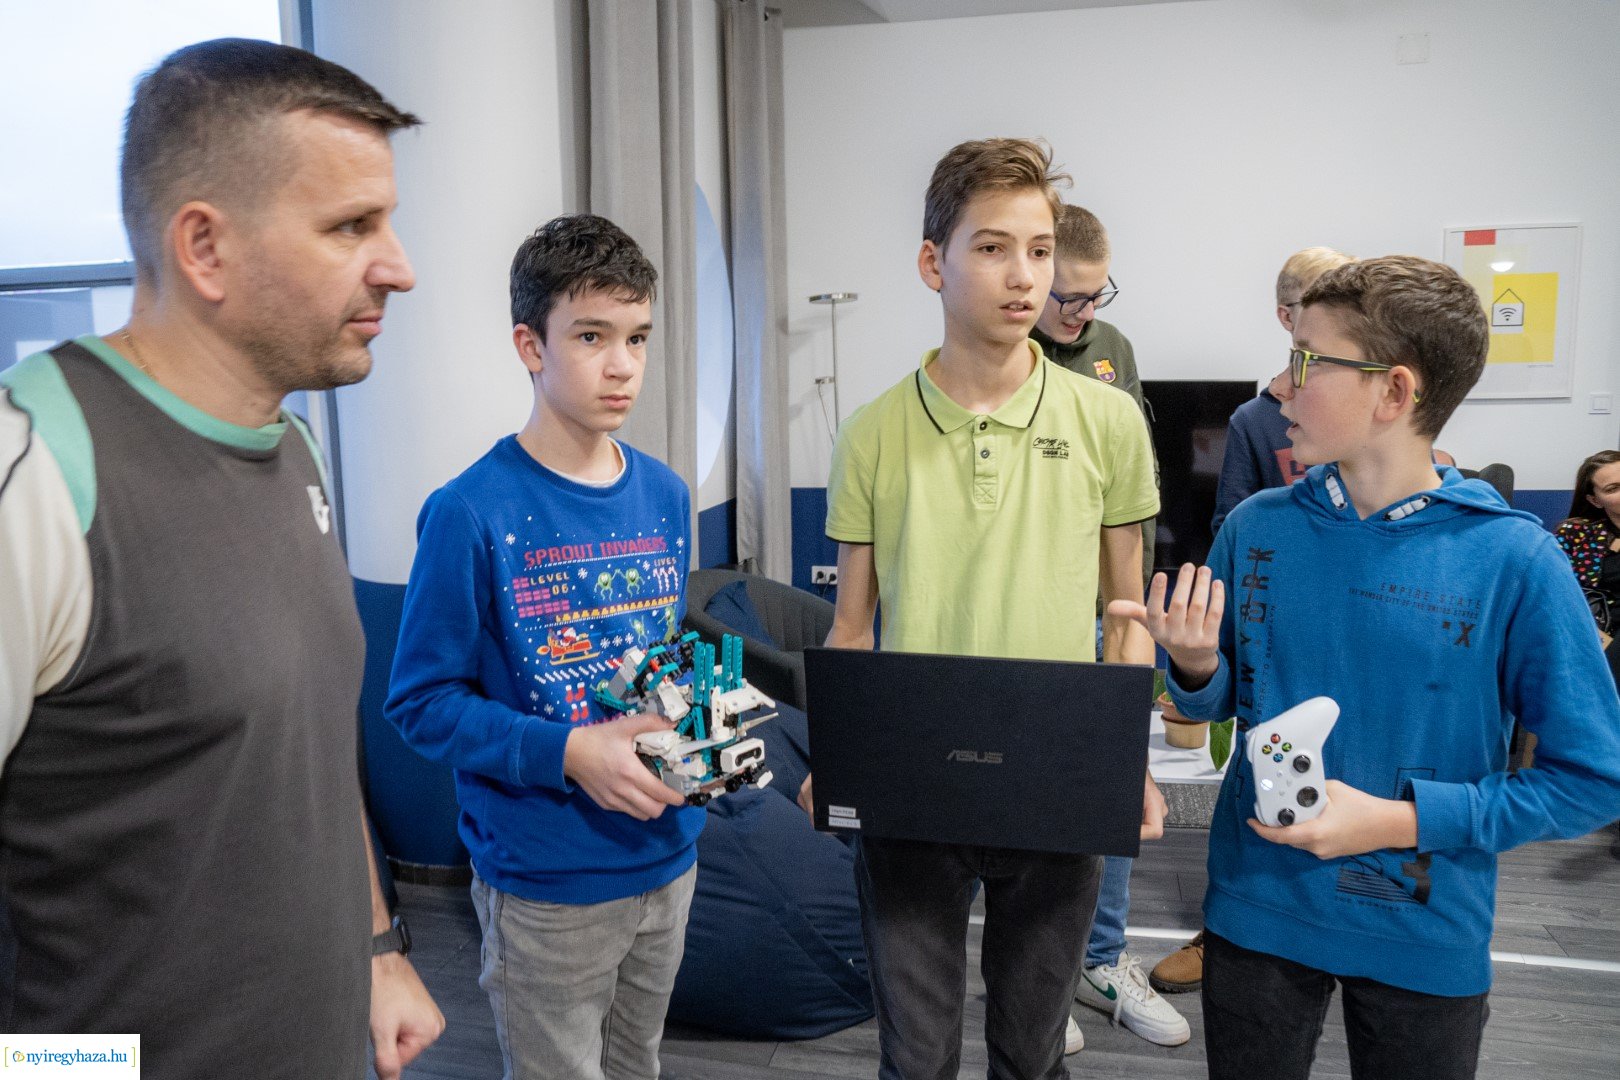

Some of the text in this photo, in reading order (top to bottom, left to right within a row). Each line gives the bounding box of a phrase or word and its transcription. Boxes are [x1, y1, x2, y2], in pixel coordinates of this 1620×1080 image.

[524, 536, 667, 568] SPROUT INVADERS
[653, 556, 677, 567] LIVES
[530, 572, 570, 586] LEVEL
[1380, 582, 1482, 609] EMPIRE STATE
[946, 750, 1003, 764] ASUS
